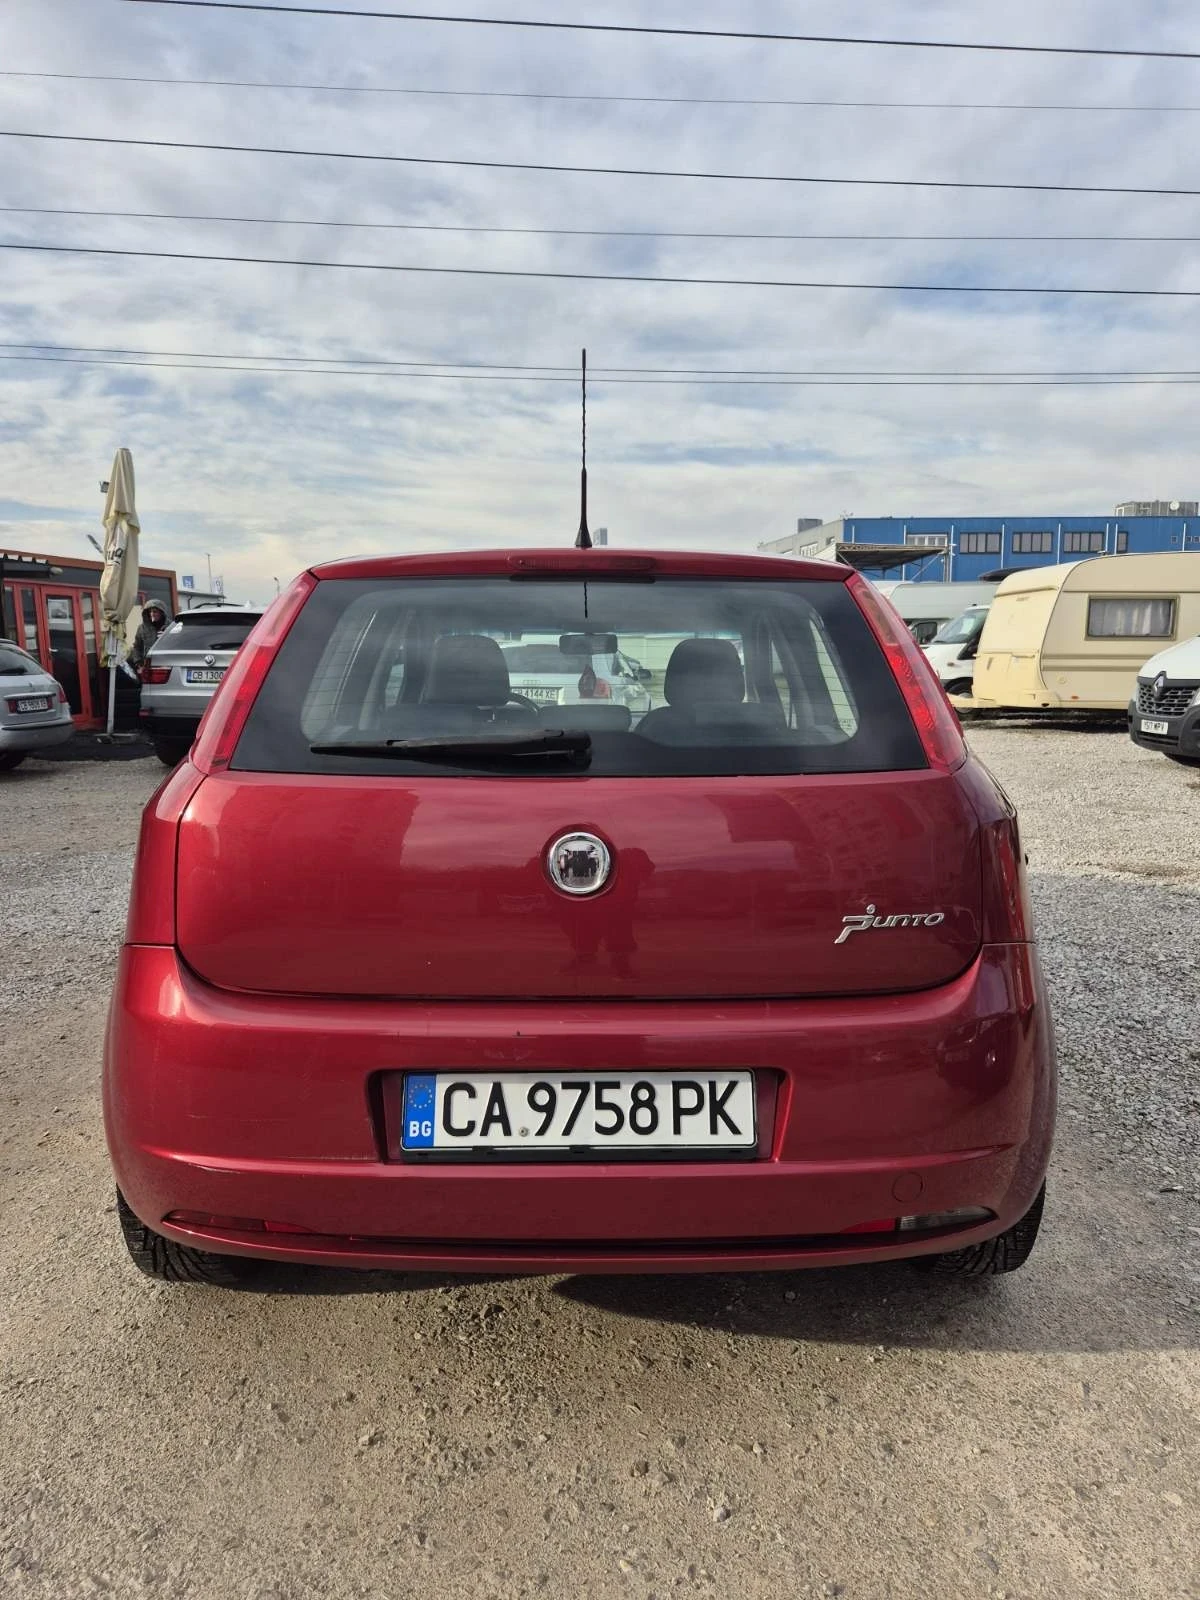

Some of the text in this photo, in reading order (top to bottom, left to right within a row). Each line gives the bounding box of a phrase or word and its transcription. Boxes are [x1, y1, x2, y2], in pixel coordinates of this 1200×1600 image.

[442, 1080, 743, 1138] CA 9758 PK
[408, 1120, 432, 1137] BG
